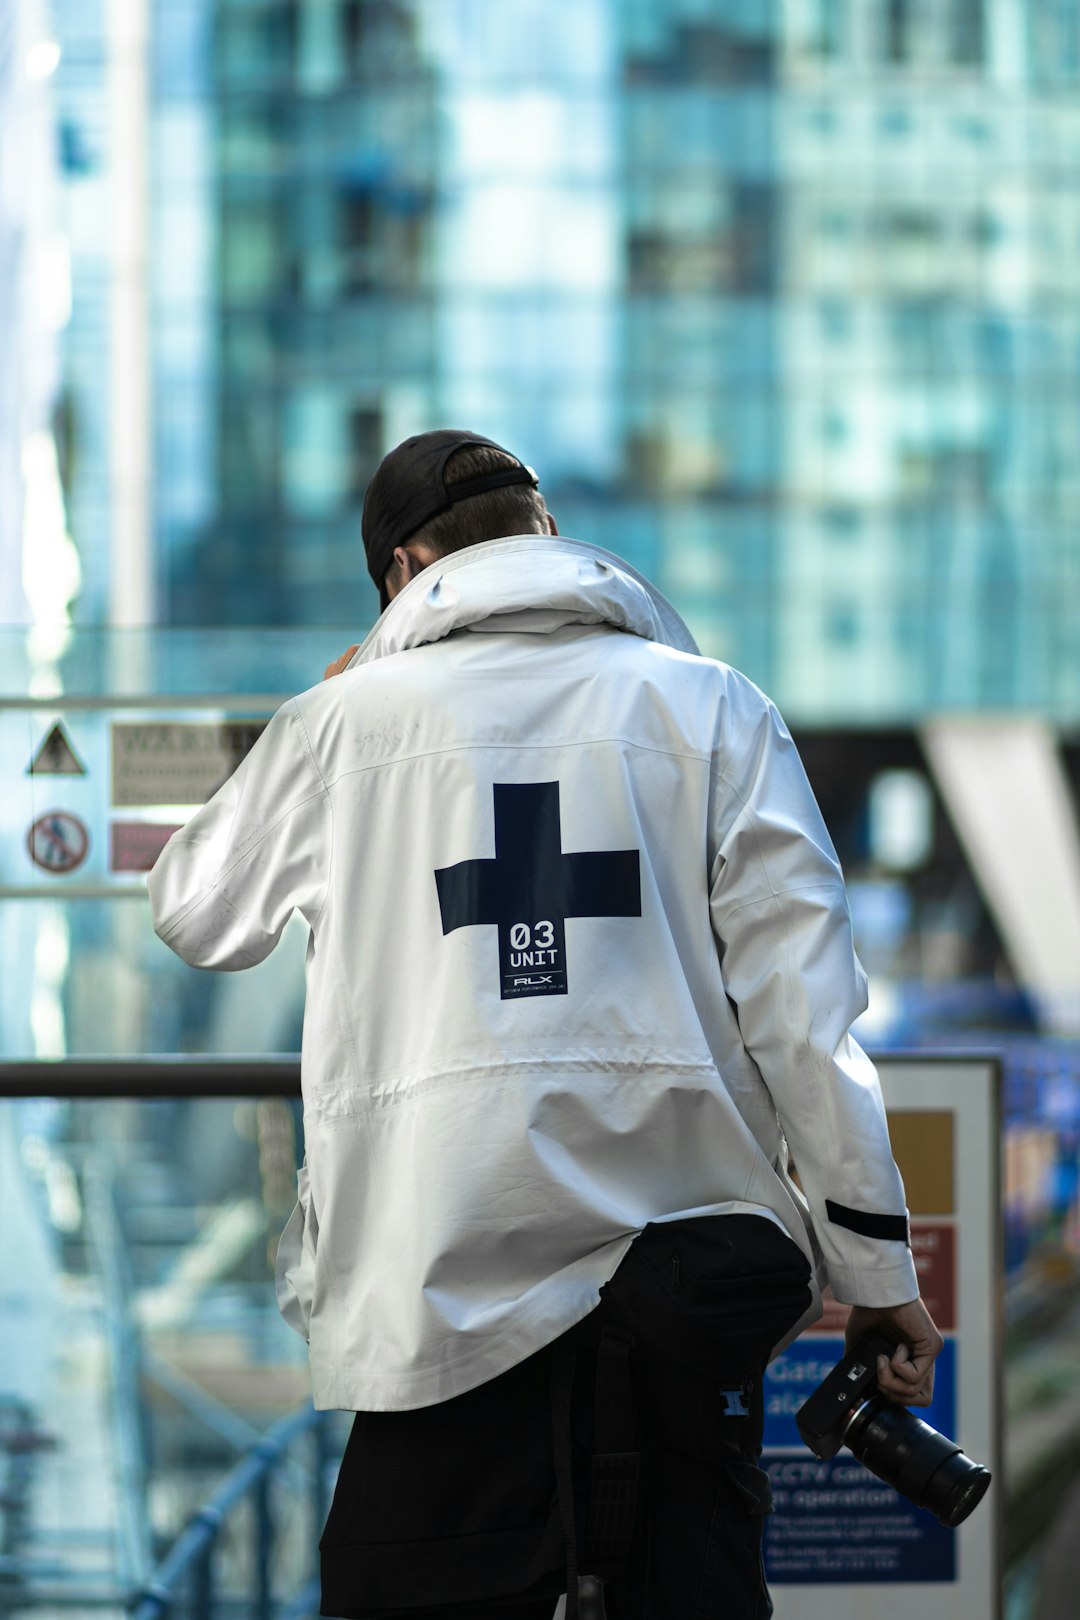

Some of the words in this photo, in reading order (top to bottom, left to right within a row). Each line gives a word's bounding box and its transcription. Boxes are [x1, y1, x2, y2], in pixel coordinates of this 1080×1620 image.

[510, 920, 555, 950] 03
[510, 949, 558, 967] UNIT
[514, 975, 553, 986] RLX
[768, 1462, 829, 1483] CCTV
[793, 1488, 897, 1508] operation
